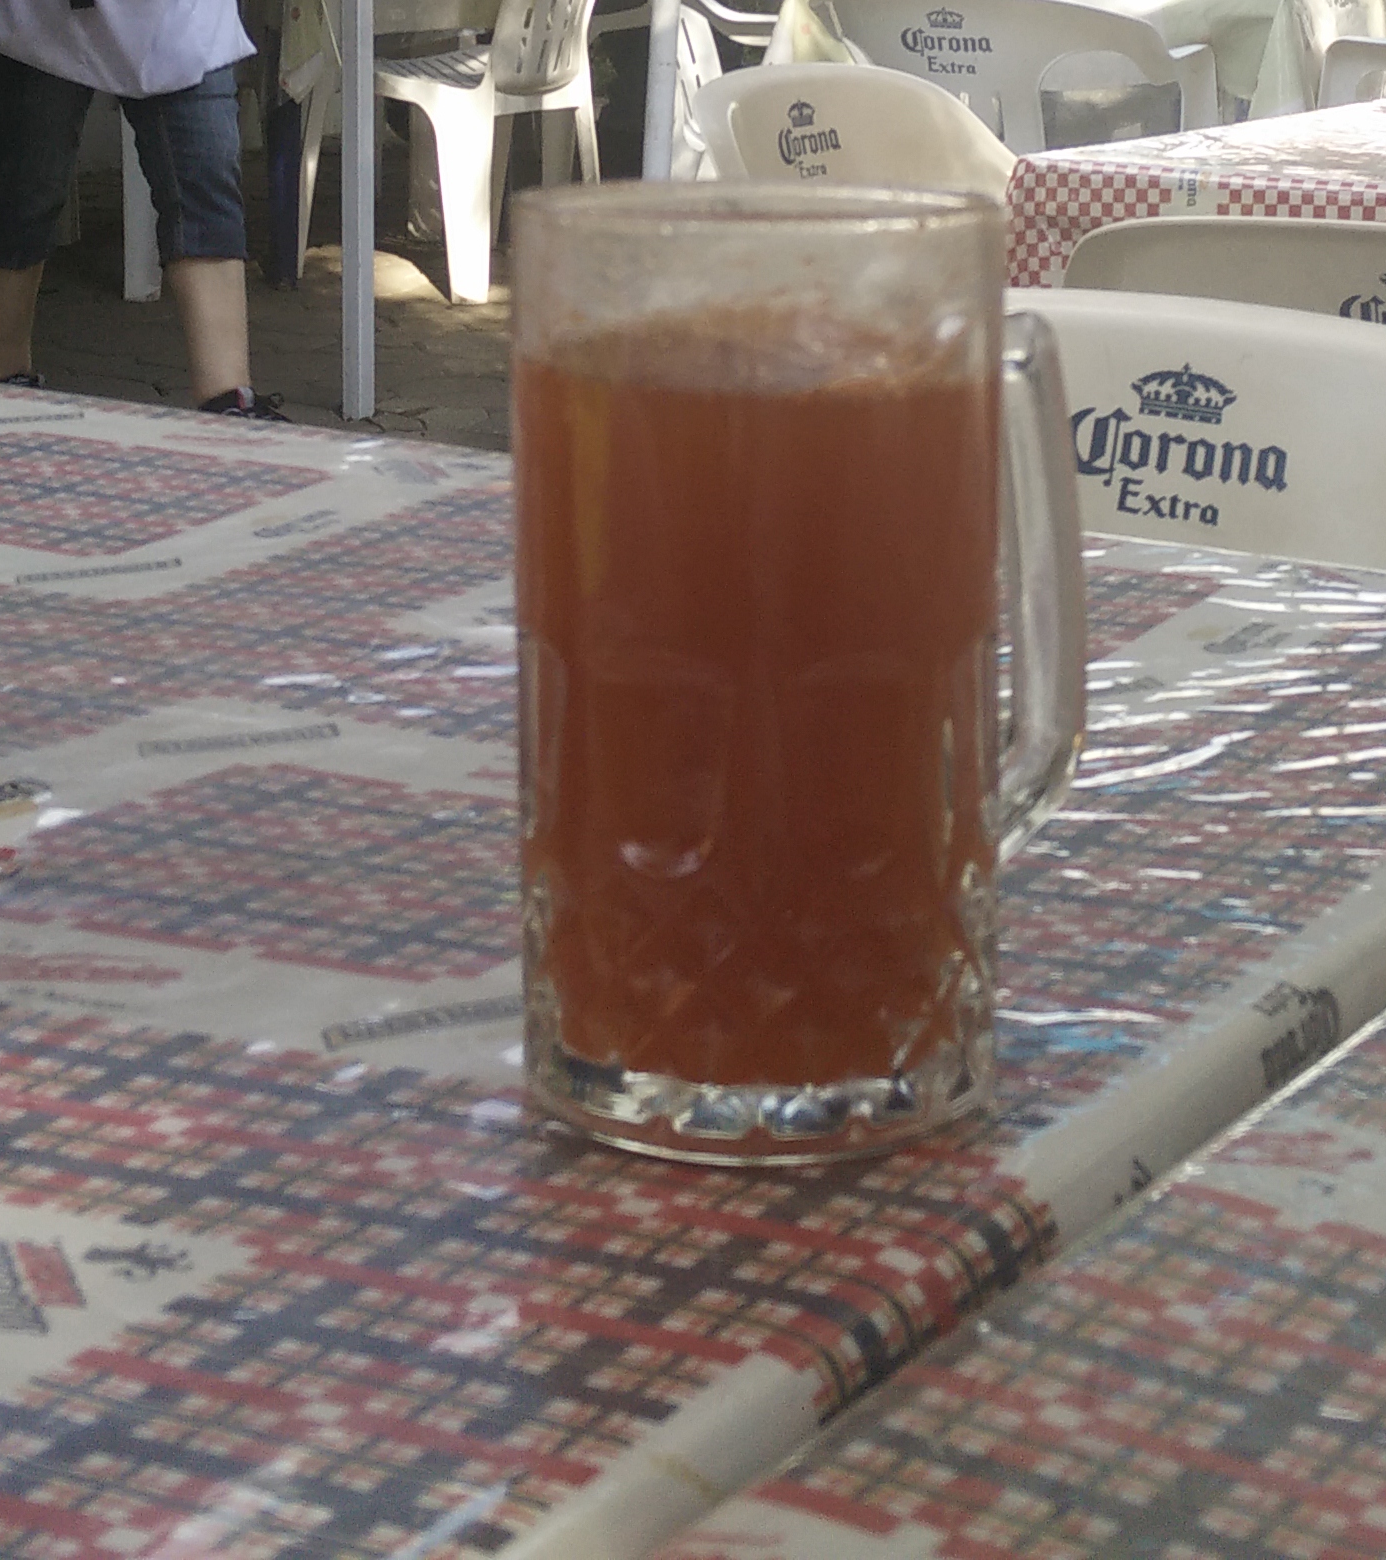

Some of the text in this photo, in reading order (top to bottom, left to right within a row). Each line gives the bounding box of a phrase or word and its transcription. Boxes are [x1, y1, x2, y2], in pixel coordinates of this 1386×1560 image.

[901, 26, 993, 57] Corona
[927, 56, 976, 75] Extra
[778, 127, 841, 166] Corona
[799, 162, 828, 179] Extra
[1071, 407, 1288, 492] Corona
[1117, 477, 1219, 527] Extra
